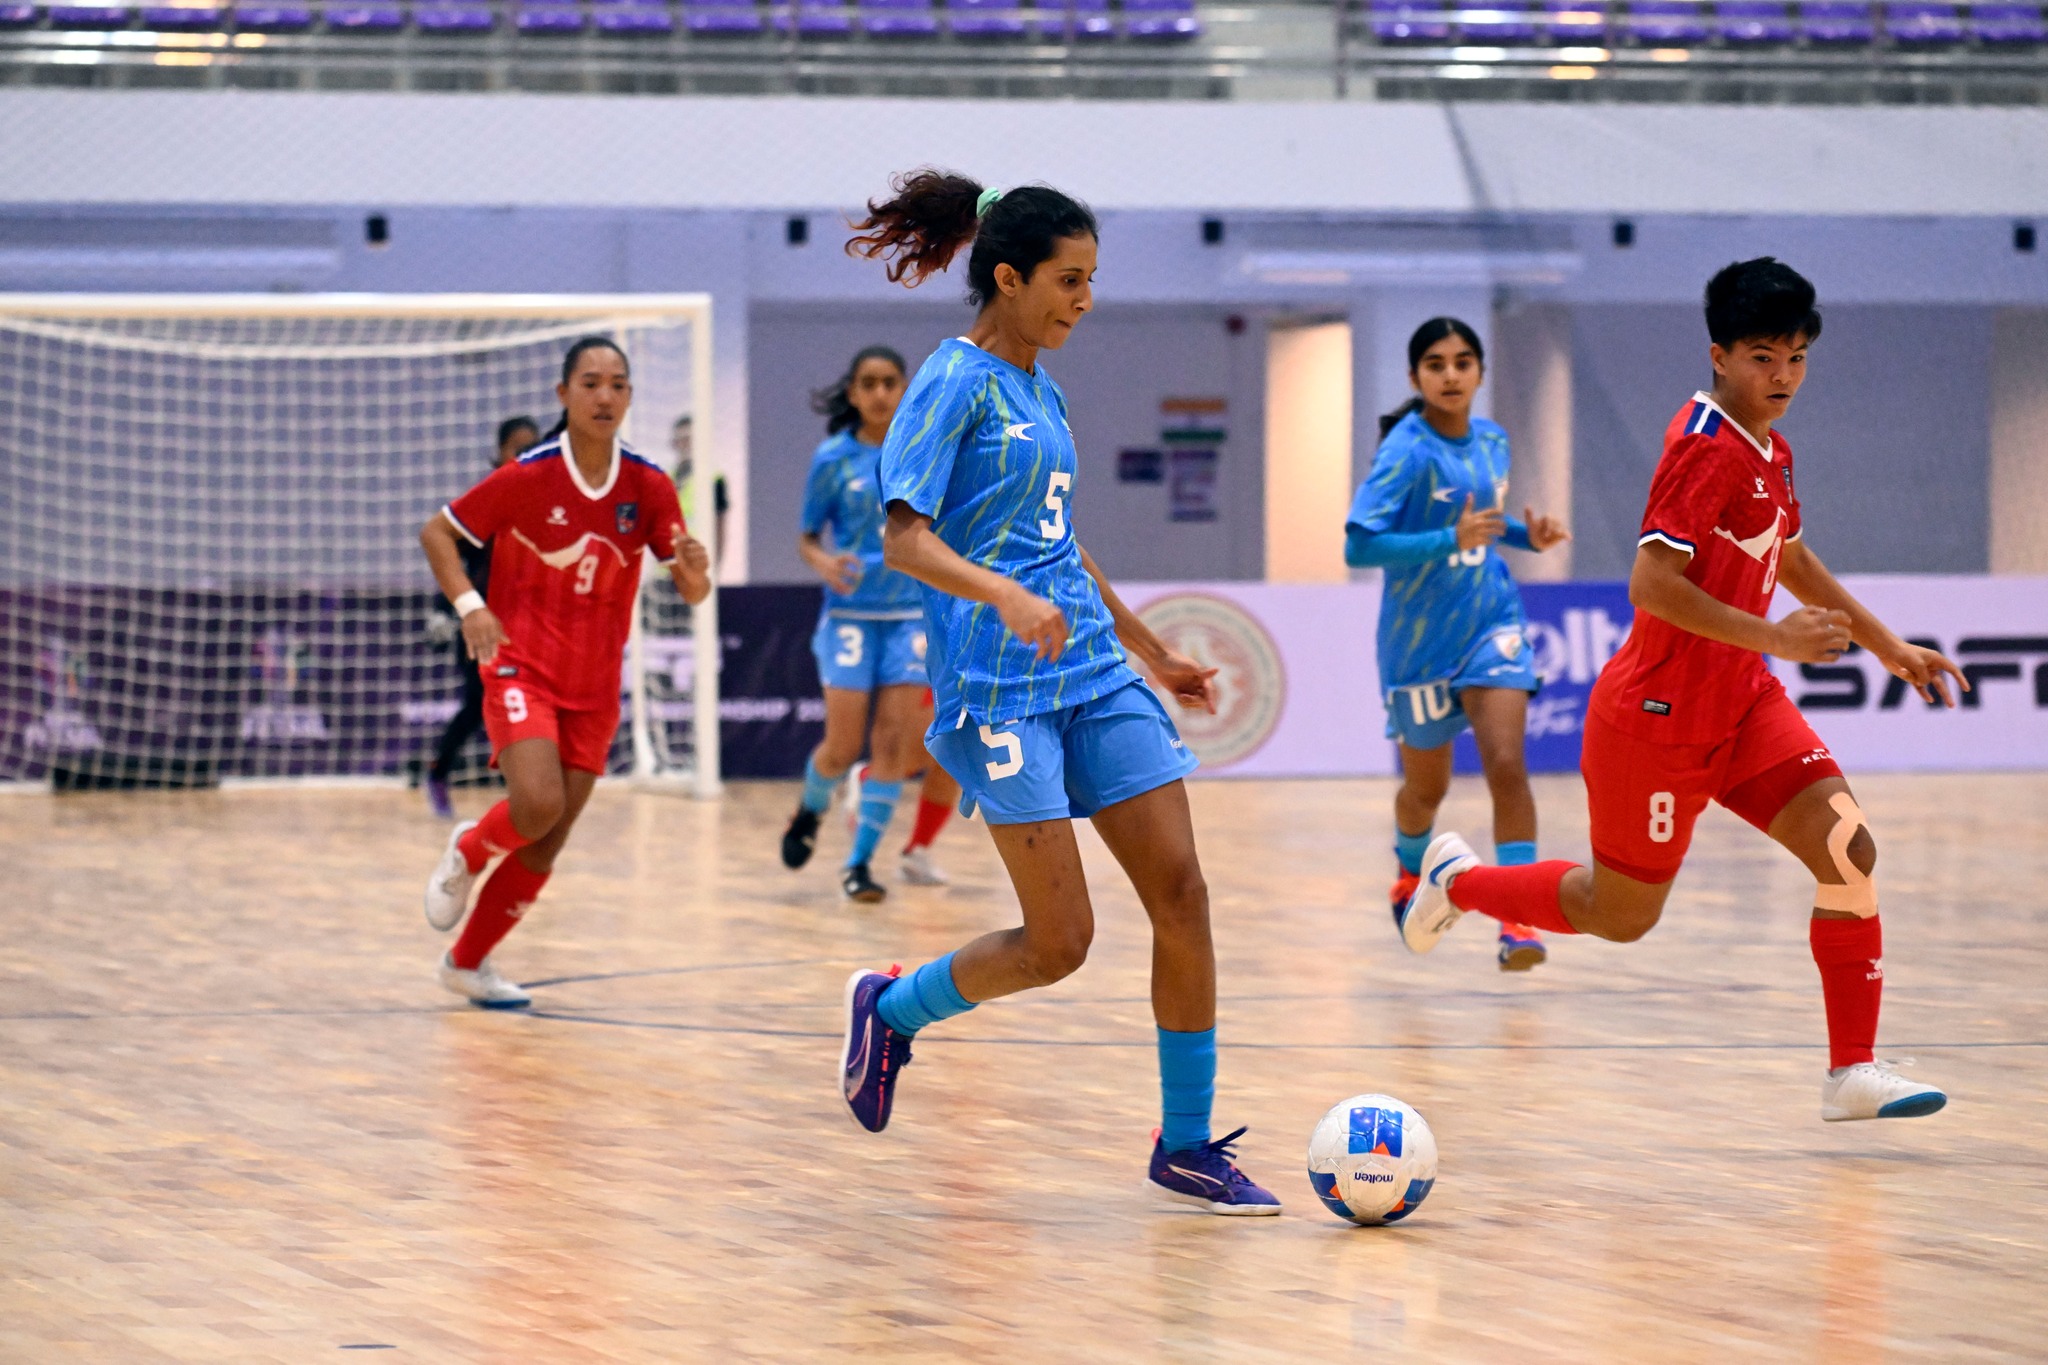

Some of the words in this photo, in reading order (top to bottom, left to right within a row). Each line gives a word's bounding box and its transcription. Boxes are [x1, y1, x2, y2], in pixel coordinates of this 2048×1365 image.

[1040, 472, 1071, 540] 5
[574, 555, 599, 595] 9
[1762, 537, 1782, 594] 8
[836, 625, 864, 667] 3
[504, 687, 528, 723] 9
[978, 719, 1024, 781] 5
[1649, 791, 1675, 843] 8
[1354, 1172, 1394, 1184] molten
